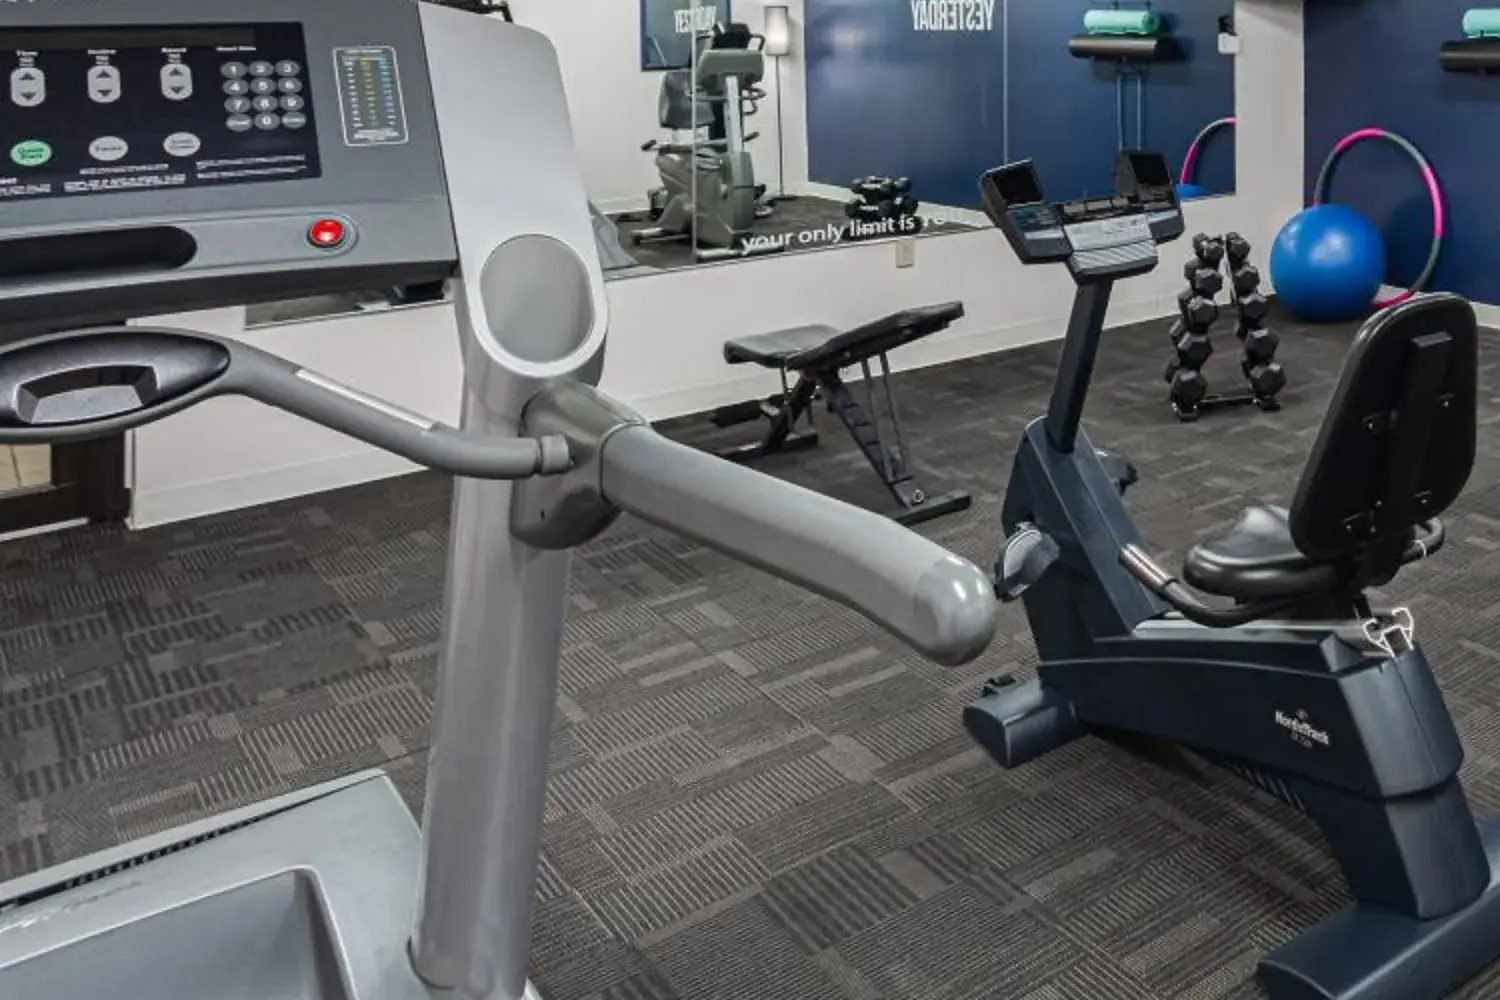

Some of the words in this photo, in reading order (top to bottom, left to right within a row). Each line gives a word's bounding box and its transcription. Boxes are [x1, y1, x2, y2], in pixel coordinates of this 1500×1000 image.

[742, 231, 793, 255] your
[800, 223, 845, 243] only
[850, 216, 894, 237] limit
[900, 214, 915, 232] is
